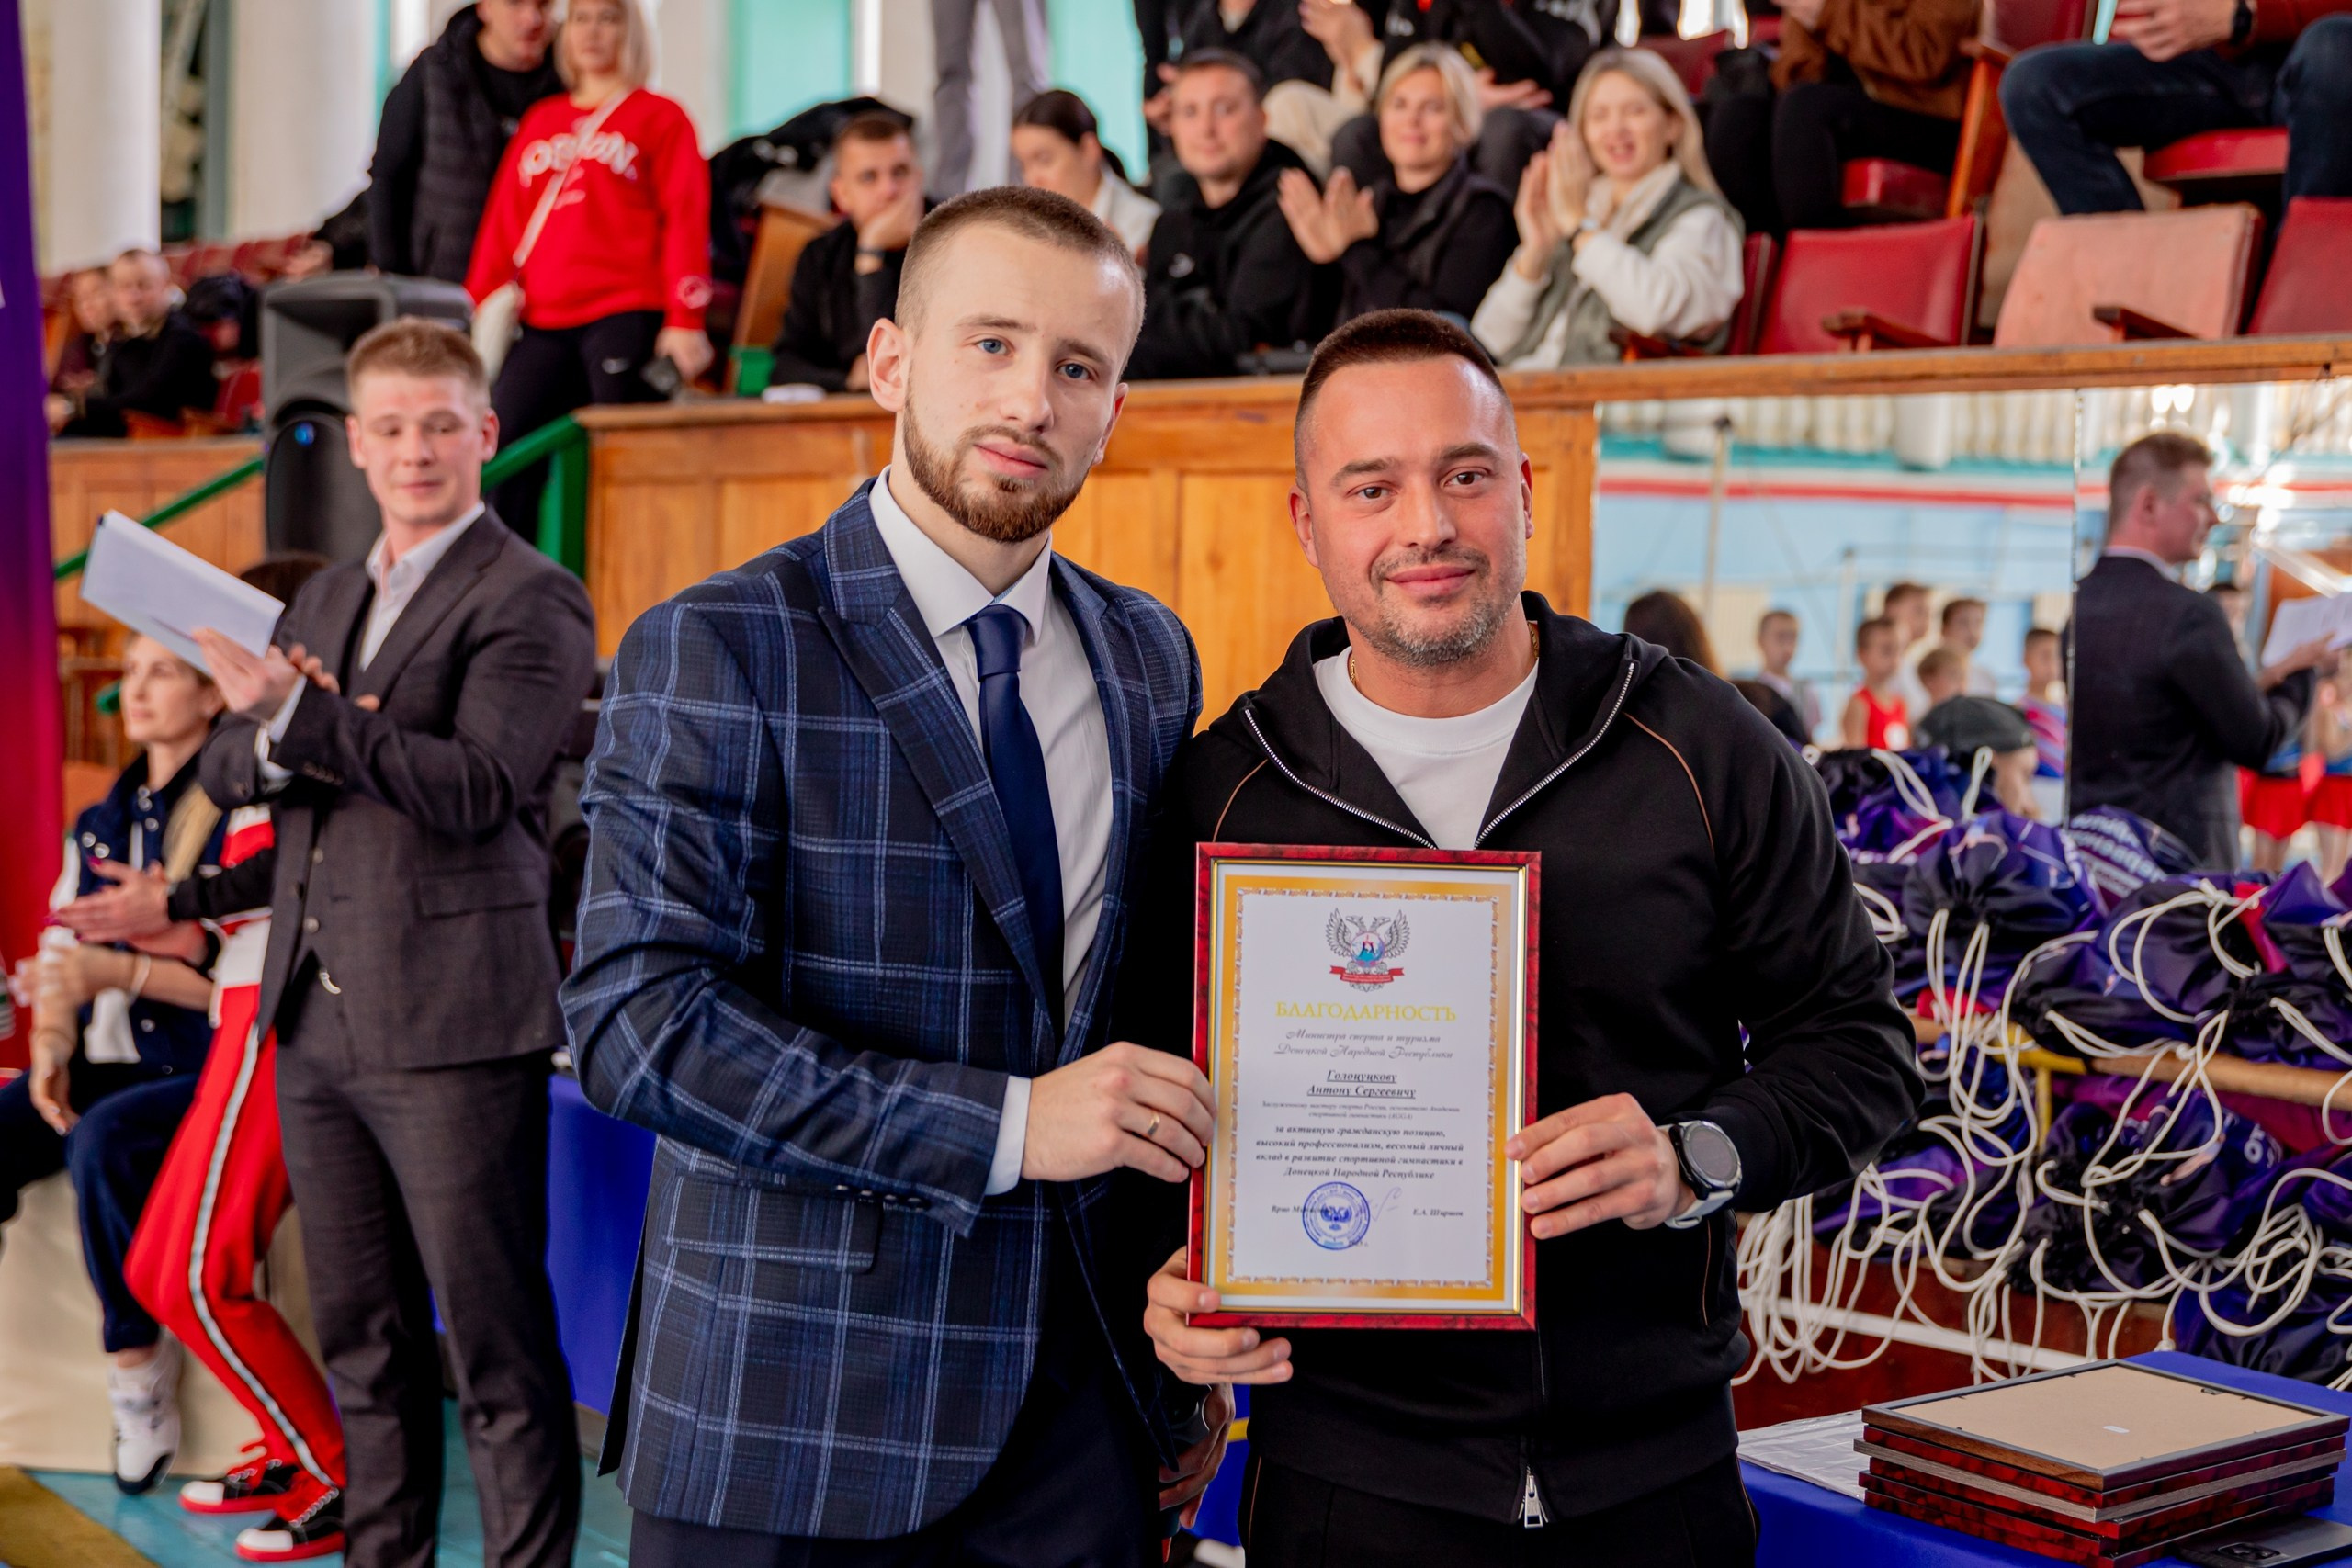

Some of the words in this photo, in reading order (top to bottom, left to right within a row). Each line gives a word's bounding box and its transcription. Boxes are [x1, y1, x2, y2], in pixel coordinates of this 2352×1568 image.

[1275, 1001, 1456, 1021] БЛАГОДАРНОСТЬ
[1286, 1029, 1346, 1043] Министра
[1349, 1034, 1384, 1043] спорта
[1396, 1035, 1441, 1045] туризма
[1274, 1043, 1328, 1055] Донецкой
[1329, 1044, 1385, 1059] Народной
[1388, 1045, 1453, 1061] Республики
[1327, 1069, 1396, 1083] Голоцуцкову
[1307, 1085, 1351, 1097] Антону
[1355, 1085, 1416, 1099] Сергеевичу
[1287, 1126, 1334, 1135] активную
[1337, 1127, 1400, 1137] гражданскую
[1403, 1129, 1446, 1138] позицию,
[1256, 1139, 1295, 1147] высокий
[1297, 1139, 1384, 1150] профессионализм,
[1385, 1142, 1426, 1150] весомый
[1428, 1143, 1464, 1152] личный
[1256, 1153, 1283, 1161] вклад
[1292, 1155, 1336, 1164] развитие
[1339, 1155, 1396, 1165] спортивной
[1397, 1157, 1456, 1166] гимнастики
[1283, 1167, 1330, 1177] Донецкой
[1333, 1168, 1379, 1178] Народной
[1382, 1168, 1435, 1180] Республике
